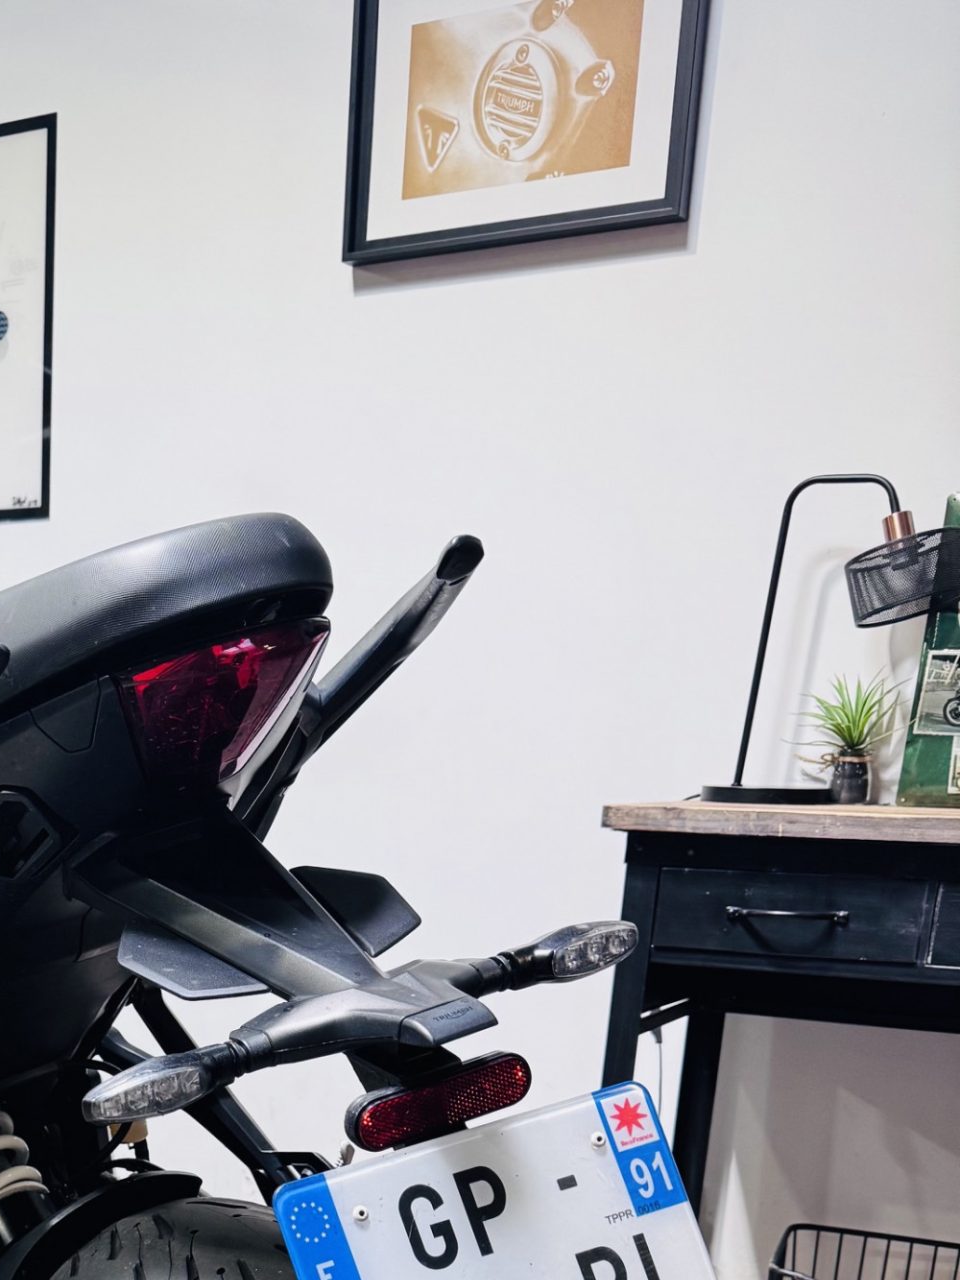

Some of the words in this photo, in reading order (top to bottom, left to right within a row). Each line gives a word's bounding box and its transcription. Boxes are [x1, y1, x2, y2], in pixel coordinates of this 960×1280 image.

[497, 92, 535, 114] TRIUMPH
[432, 1005, 474, 1022] TRIUMPH
[629, 1151, 674, 1199] 91
[397, 1165, 507, 1270] GP
[604, 1208, 634, 1225] TPPR
